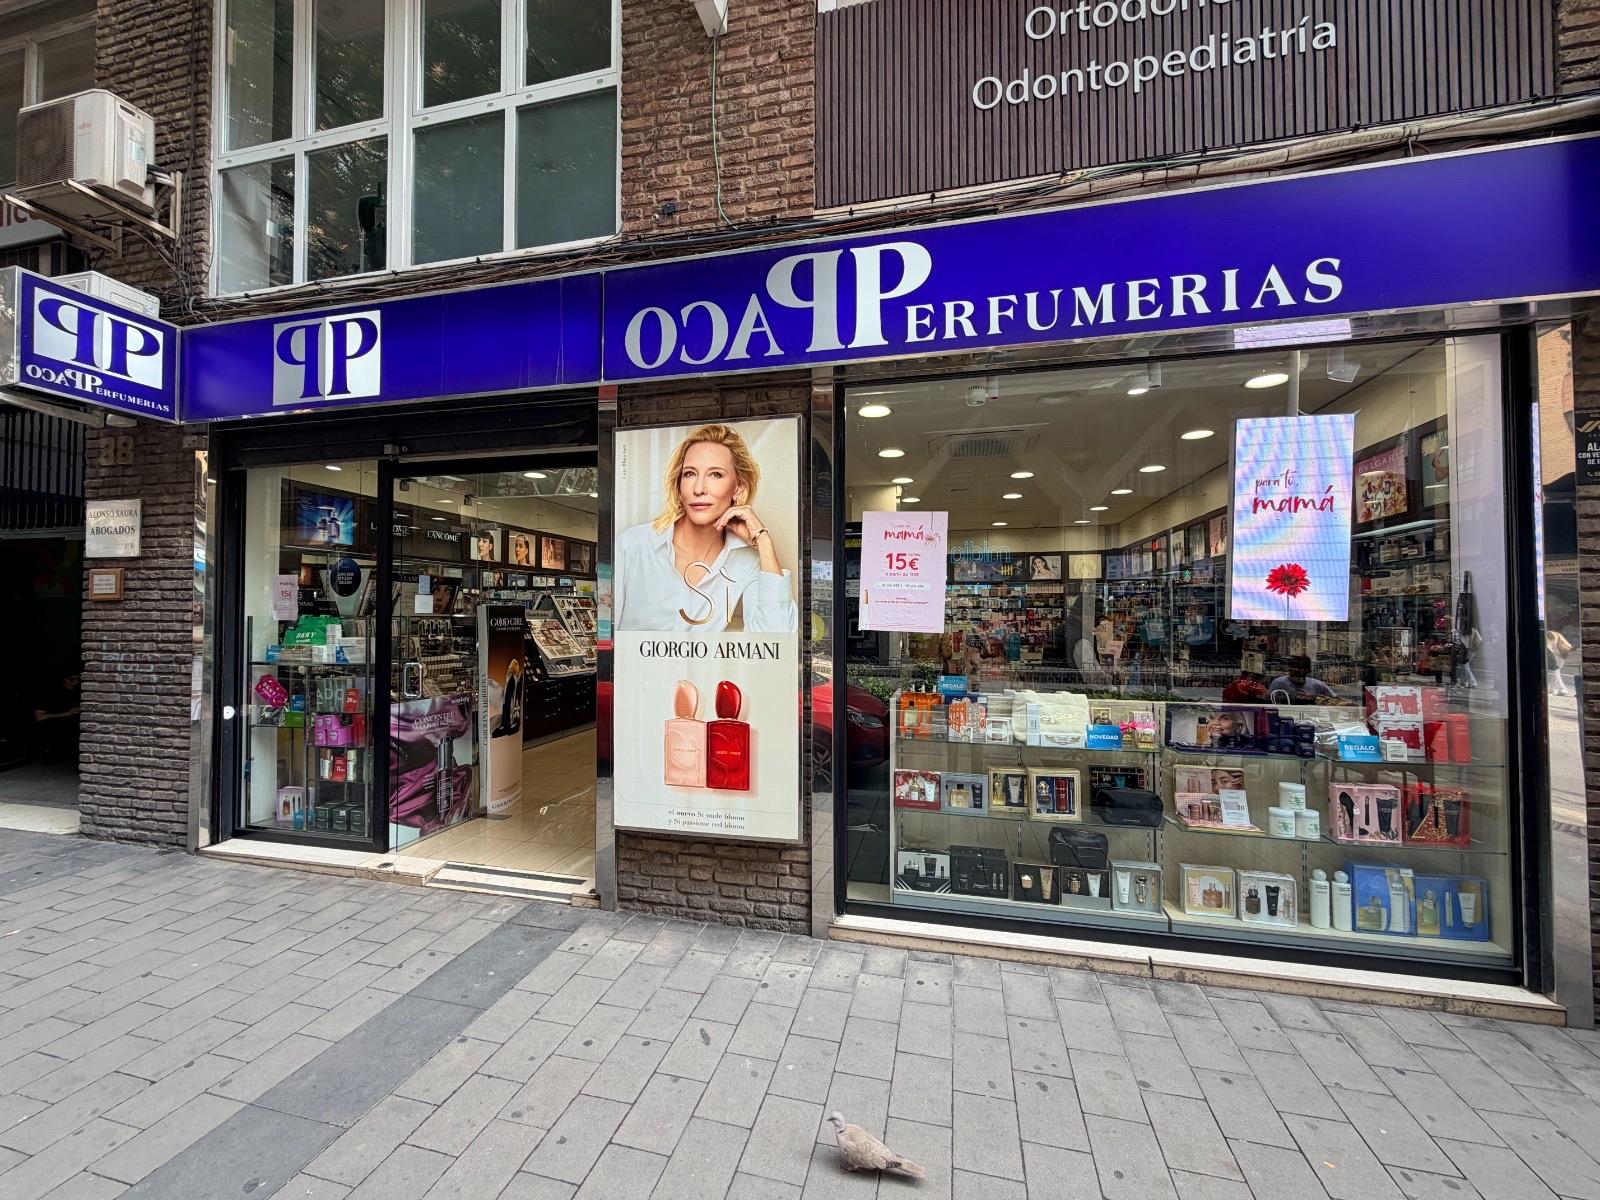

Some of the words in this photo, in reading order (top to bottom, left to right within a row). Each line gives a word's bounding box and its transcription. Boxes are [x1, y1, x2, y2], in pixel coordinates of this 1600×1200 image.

[972, 15, 1337, 111] Odontopediatría
[847, 242, 1344, 348] PERFUMERIAS
[1255, 477, 1280, 493] para
[1252, 485, 1335, 514] mamá
[88, 510, 115, 519] ALONSO
[115, 509, 138, 518] SAURA
[89, 525, 136, 536] ABOGADOS
[884, 525, 924, 541] mamá
[886, 552, 919, 570] 15€
[639, 640, 708, 659] GIORGIO
[713, 642, 780, 660] ARMANI
[724, 813, 745, 821] bloom
[724, 821, 745, 830] bloom
